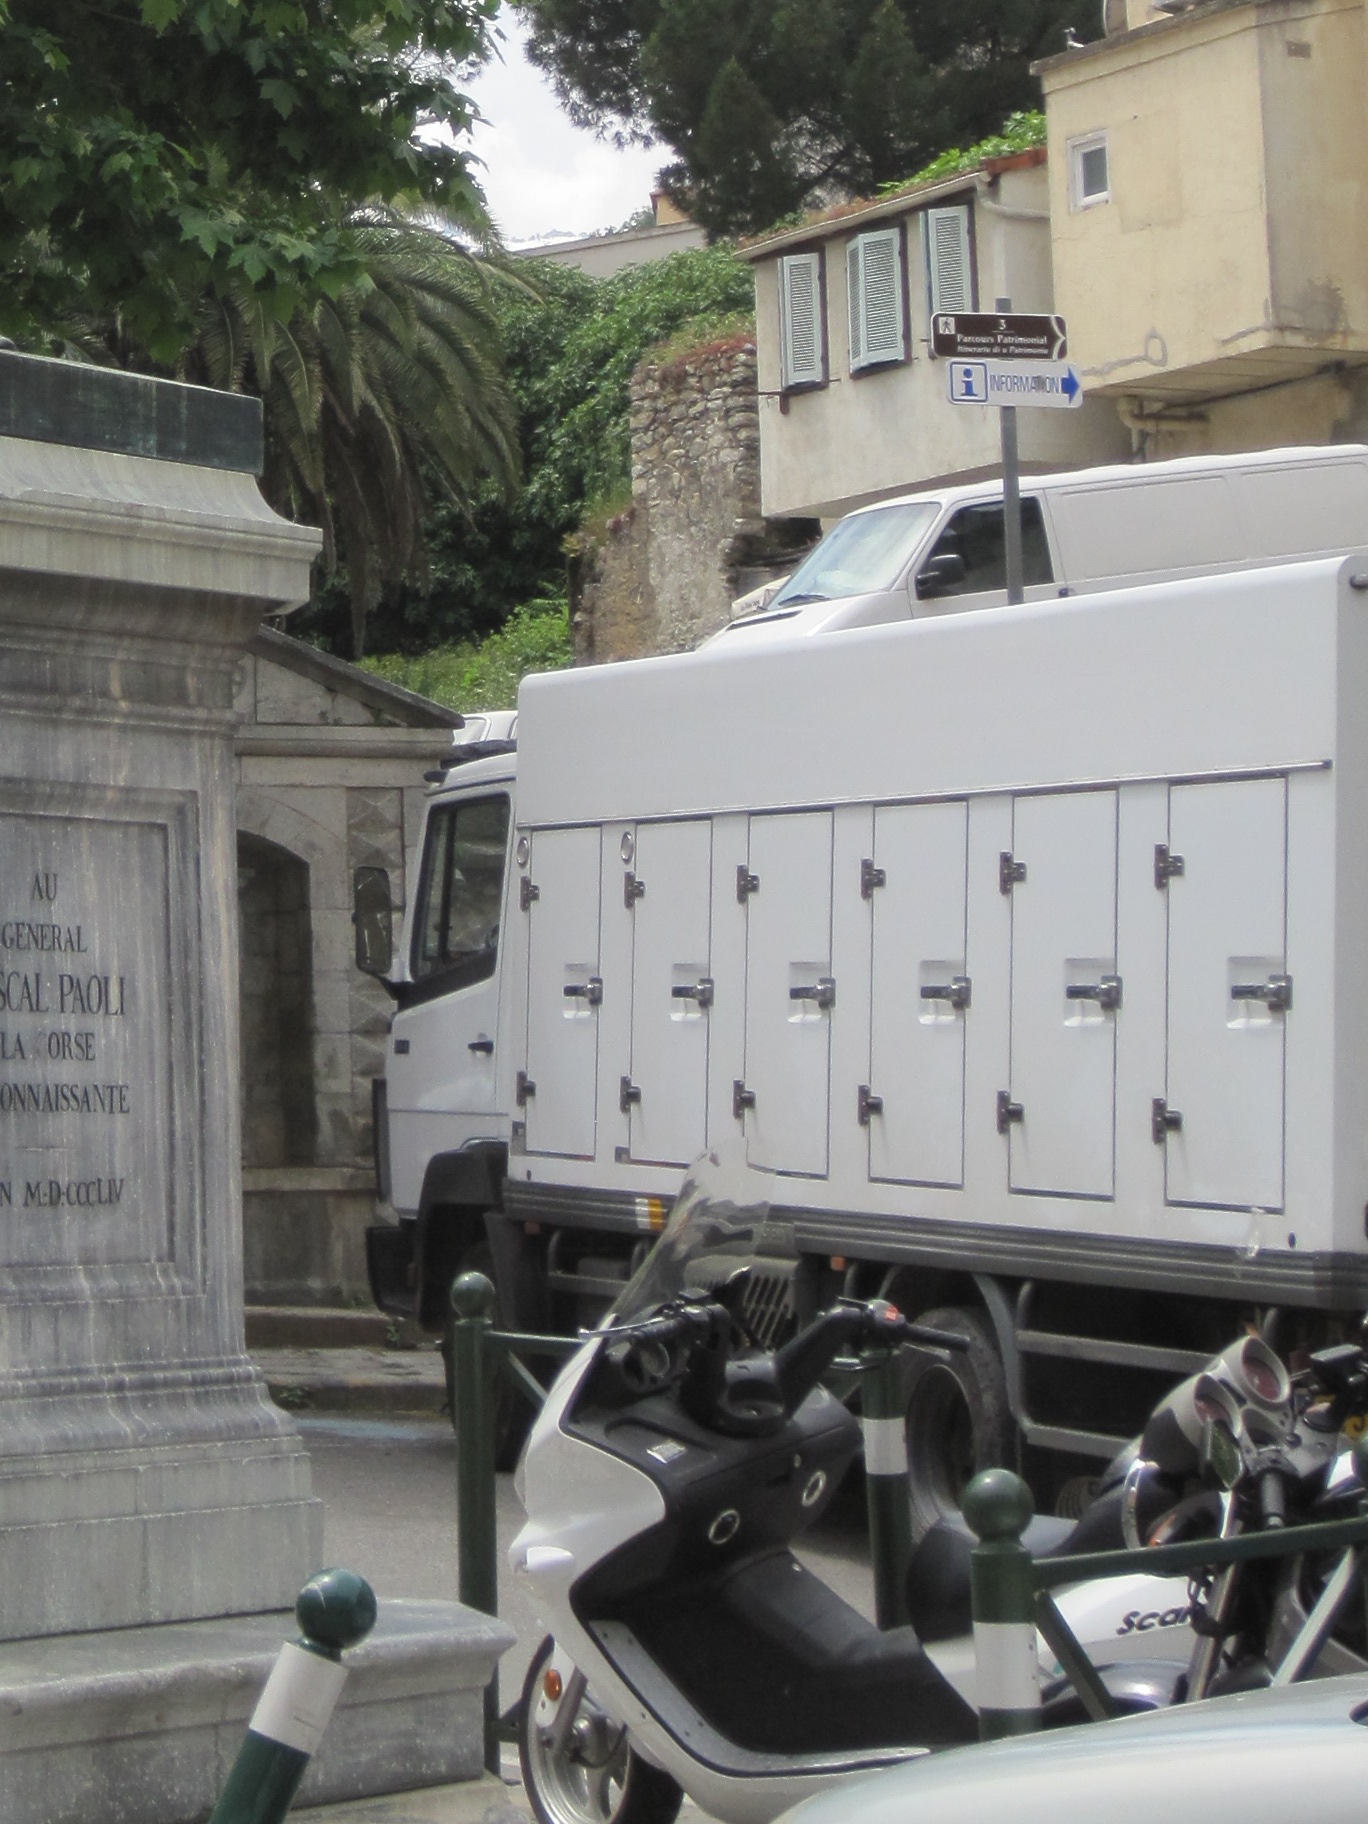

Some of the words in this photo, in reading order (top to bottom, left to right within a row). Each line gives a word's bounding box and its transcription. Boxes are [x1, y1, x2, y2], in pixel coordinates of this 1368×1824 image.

[998, 319, 1007, 330] 3
[957, 334, 994, 344] Parcours
[997, 334, 1048, 345] Patrimonial
[989, 374, 1060, 394] INFORMATION
[31, 873, 58, 902] AU
[1, 921, 88, 953] GENERAL
[58, 973, 126, 1016] PAOLI
[0, 1031, 26, 1060] LA
